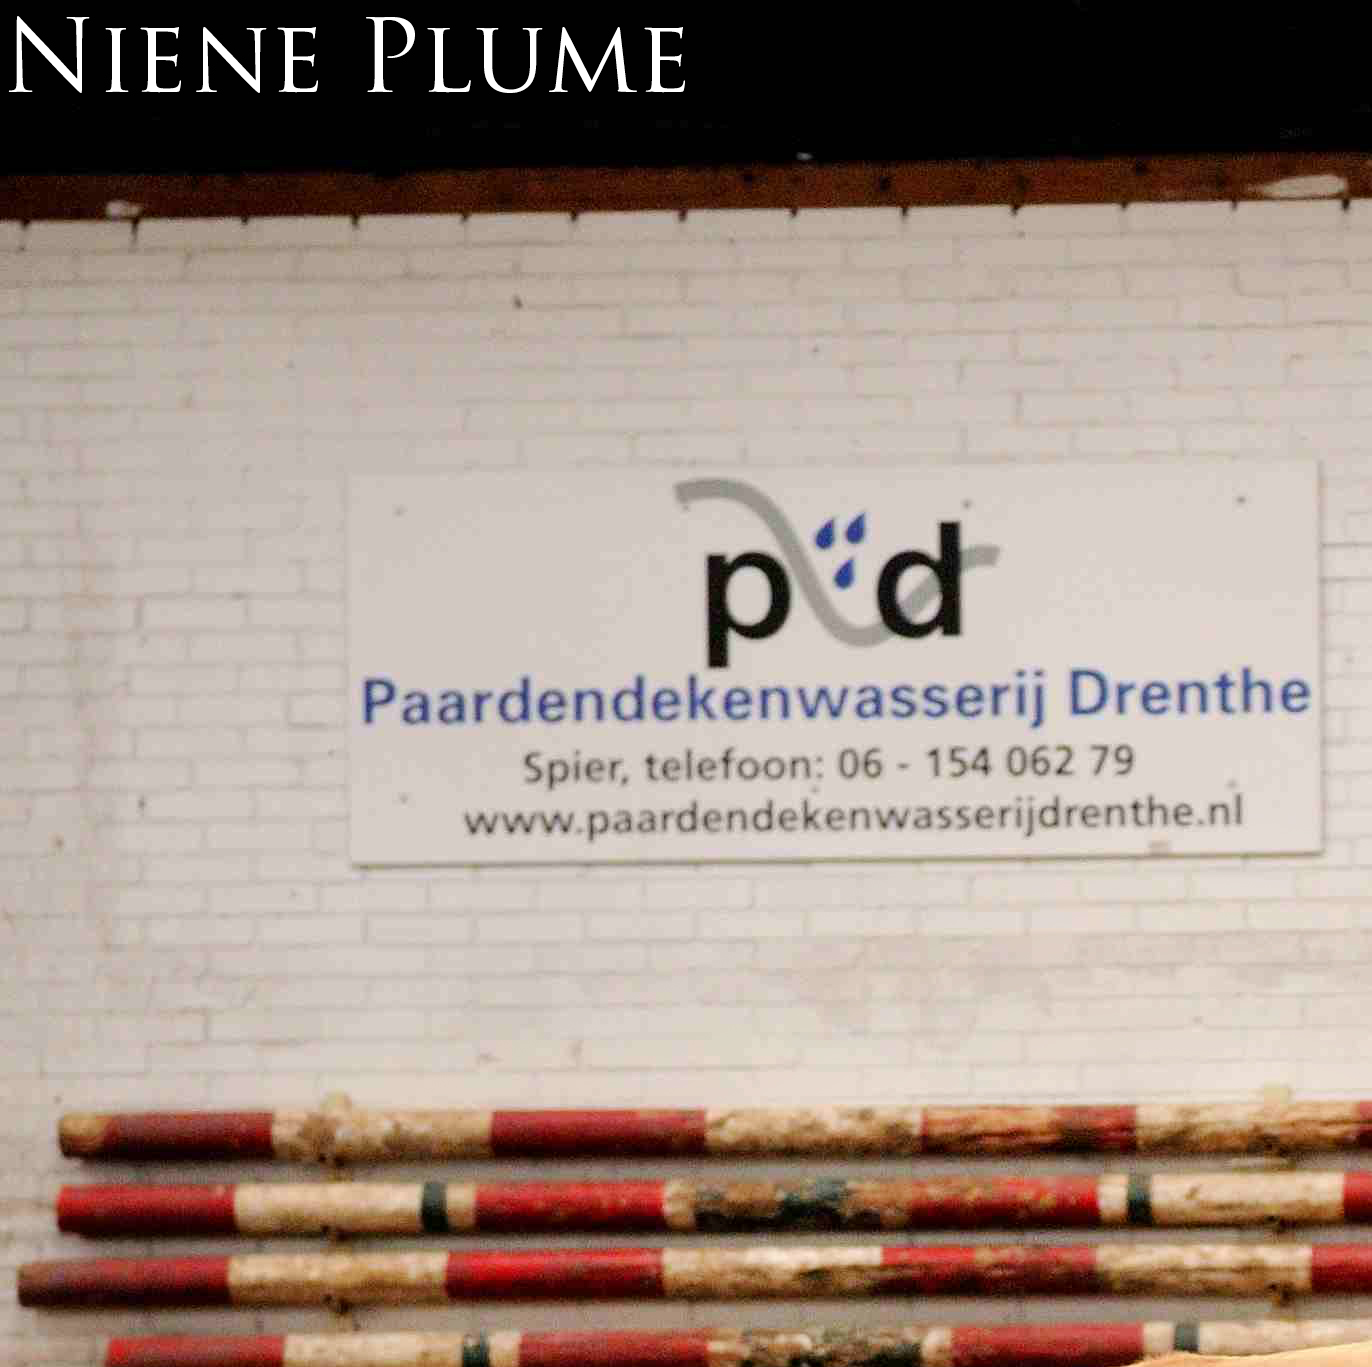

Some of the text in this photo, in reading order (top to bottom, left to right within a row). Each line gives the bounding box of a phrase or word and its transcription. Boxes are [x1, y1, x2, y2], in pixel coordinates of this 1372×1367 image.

[362, 666, 1312, 729] Paardendekenwasserij Drenthe
[522, 750, 630, 790] Spier,
[643, 746, 825, 784] telefoon:
[837, 746, 884, 780] 06
[926, 744, 993, 779] 154
[1005, 744, 1075, 778] 062
[1090, 743, 1135, 777] 79
[462, 793, 1244, 842] www.paardendekenwasserijdrenthe.nl
